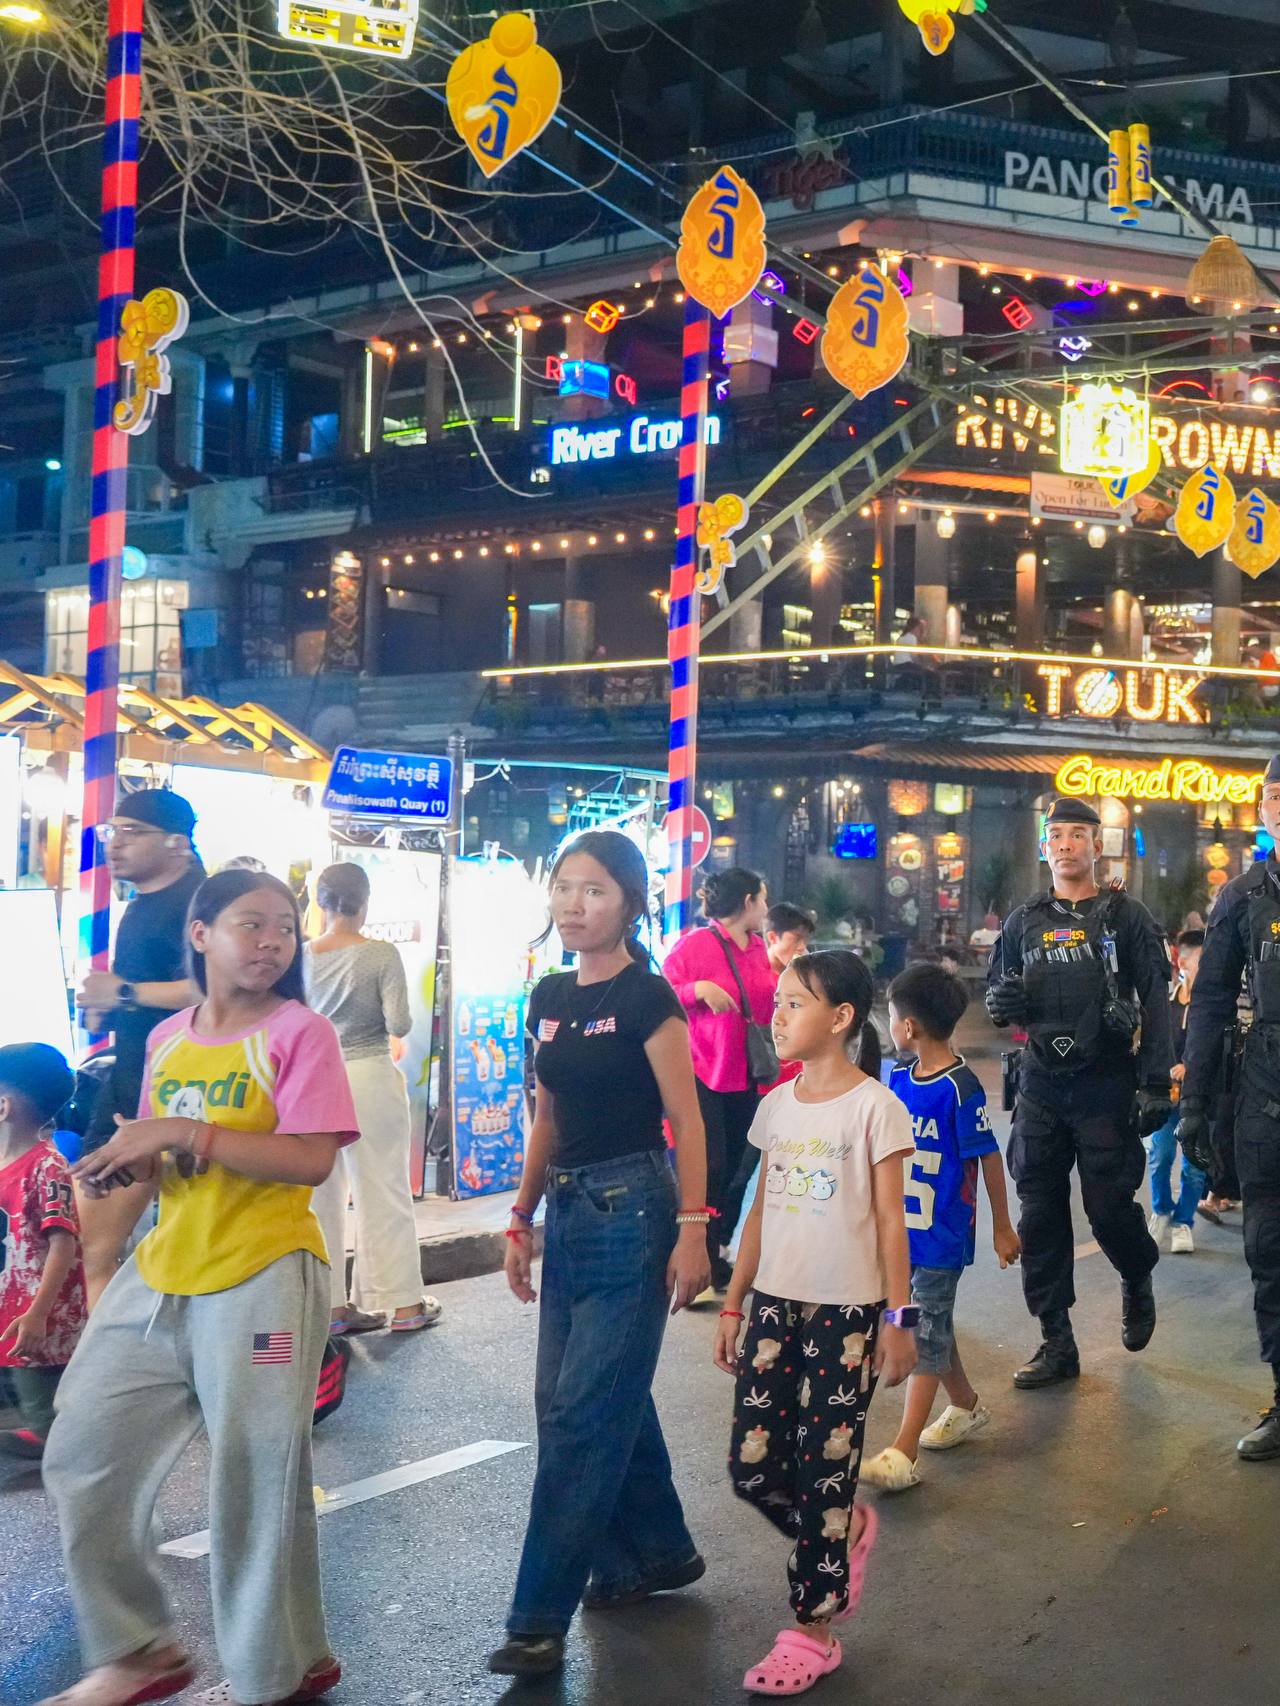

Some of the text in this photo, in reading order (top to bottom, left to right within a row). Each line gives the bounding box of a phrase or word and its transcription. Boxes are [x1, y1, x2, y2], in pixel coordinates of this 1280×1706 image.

[1004, 150, 1254, 224] PANOAMA
[551, 414, 721, 465] River Cron
[956, 395, 1059, 455] RIVE
[1037, 663, 1204, 724] TOUK
[1055, 755, 1266, 804] Grand River
[399, 797, 429, 813] Quay
[430, 799, 446, 814] (1)
[583, 1017, 617, 1037] USA
[808, 1137, 853, 1161] Well
[909, 1114, 940, 1140] HA
[902, 1149, 942, 1231] 5
